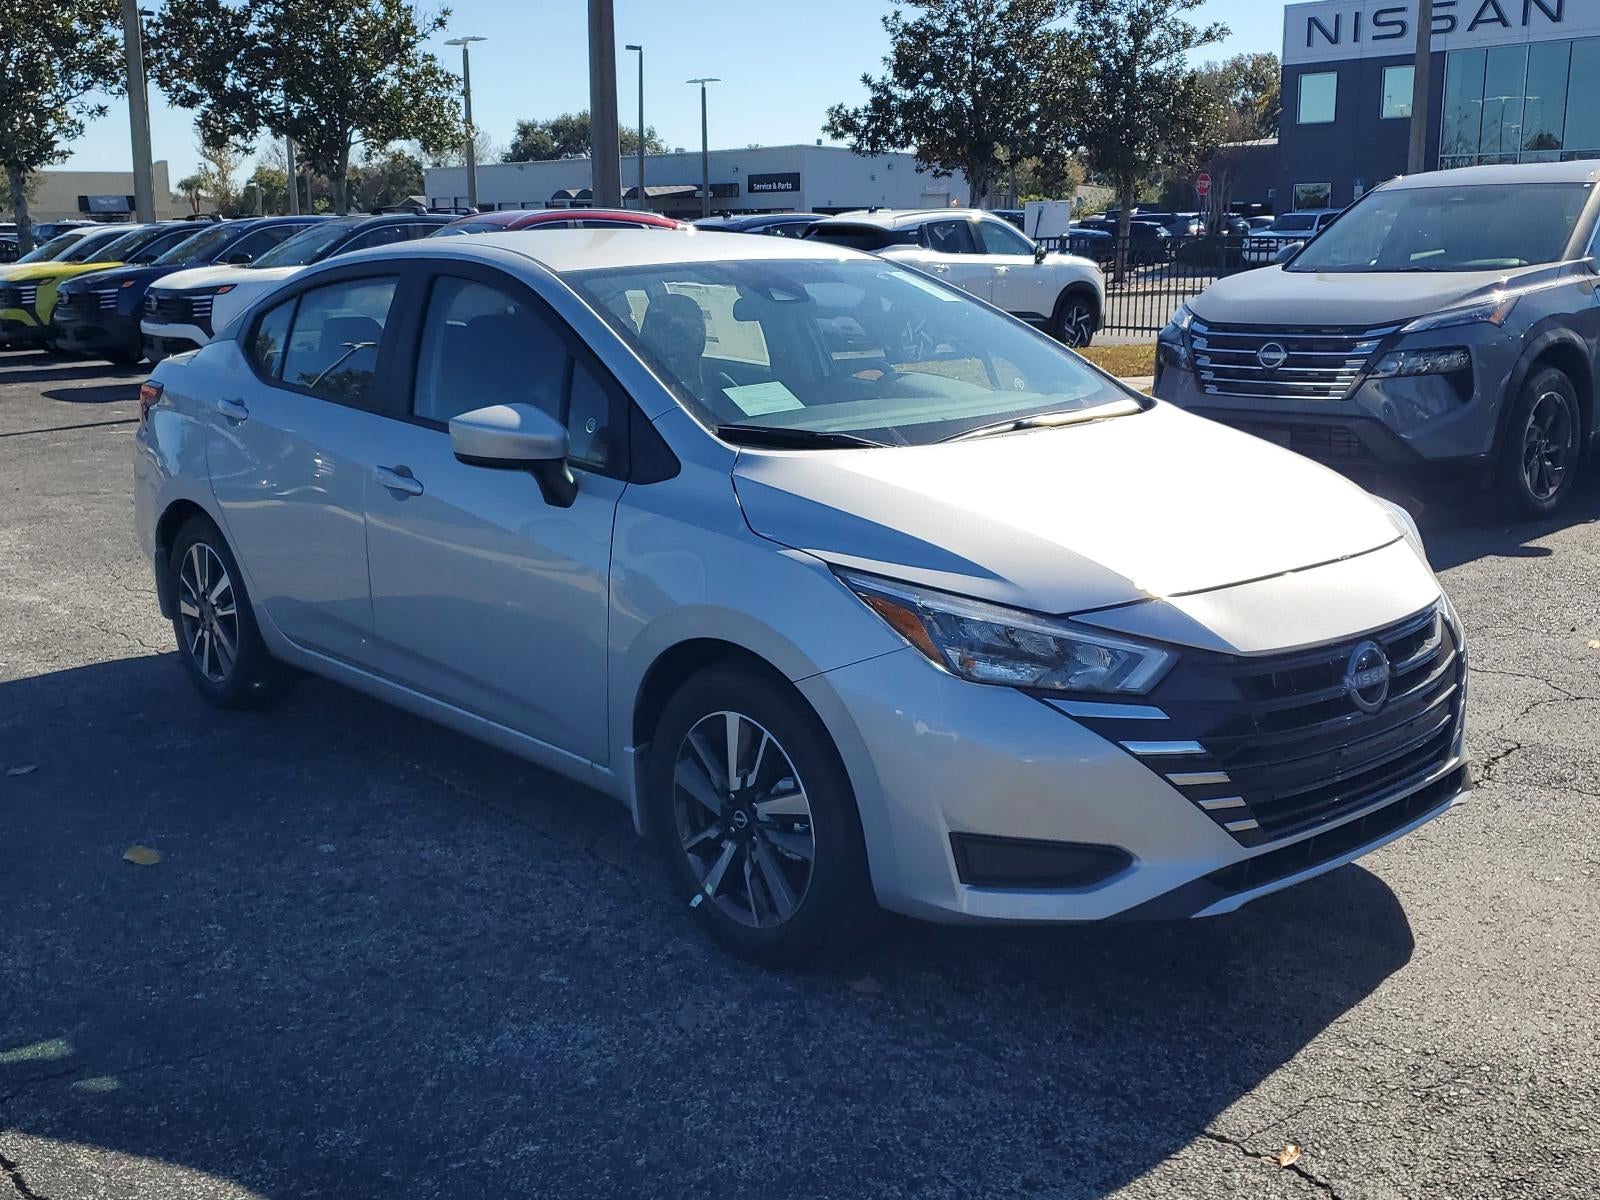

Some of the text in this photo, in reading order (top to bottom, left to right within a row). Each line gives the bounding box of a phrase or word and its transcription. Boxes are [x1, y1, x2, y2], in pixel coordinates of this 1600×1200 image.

[1306, 0, 1562, 47] NISSAN
[753, 181, 792, 191] Service & Parts
[1197, 180, 1211, 189] STOP
